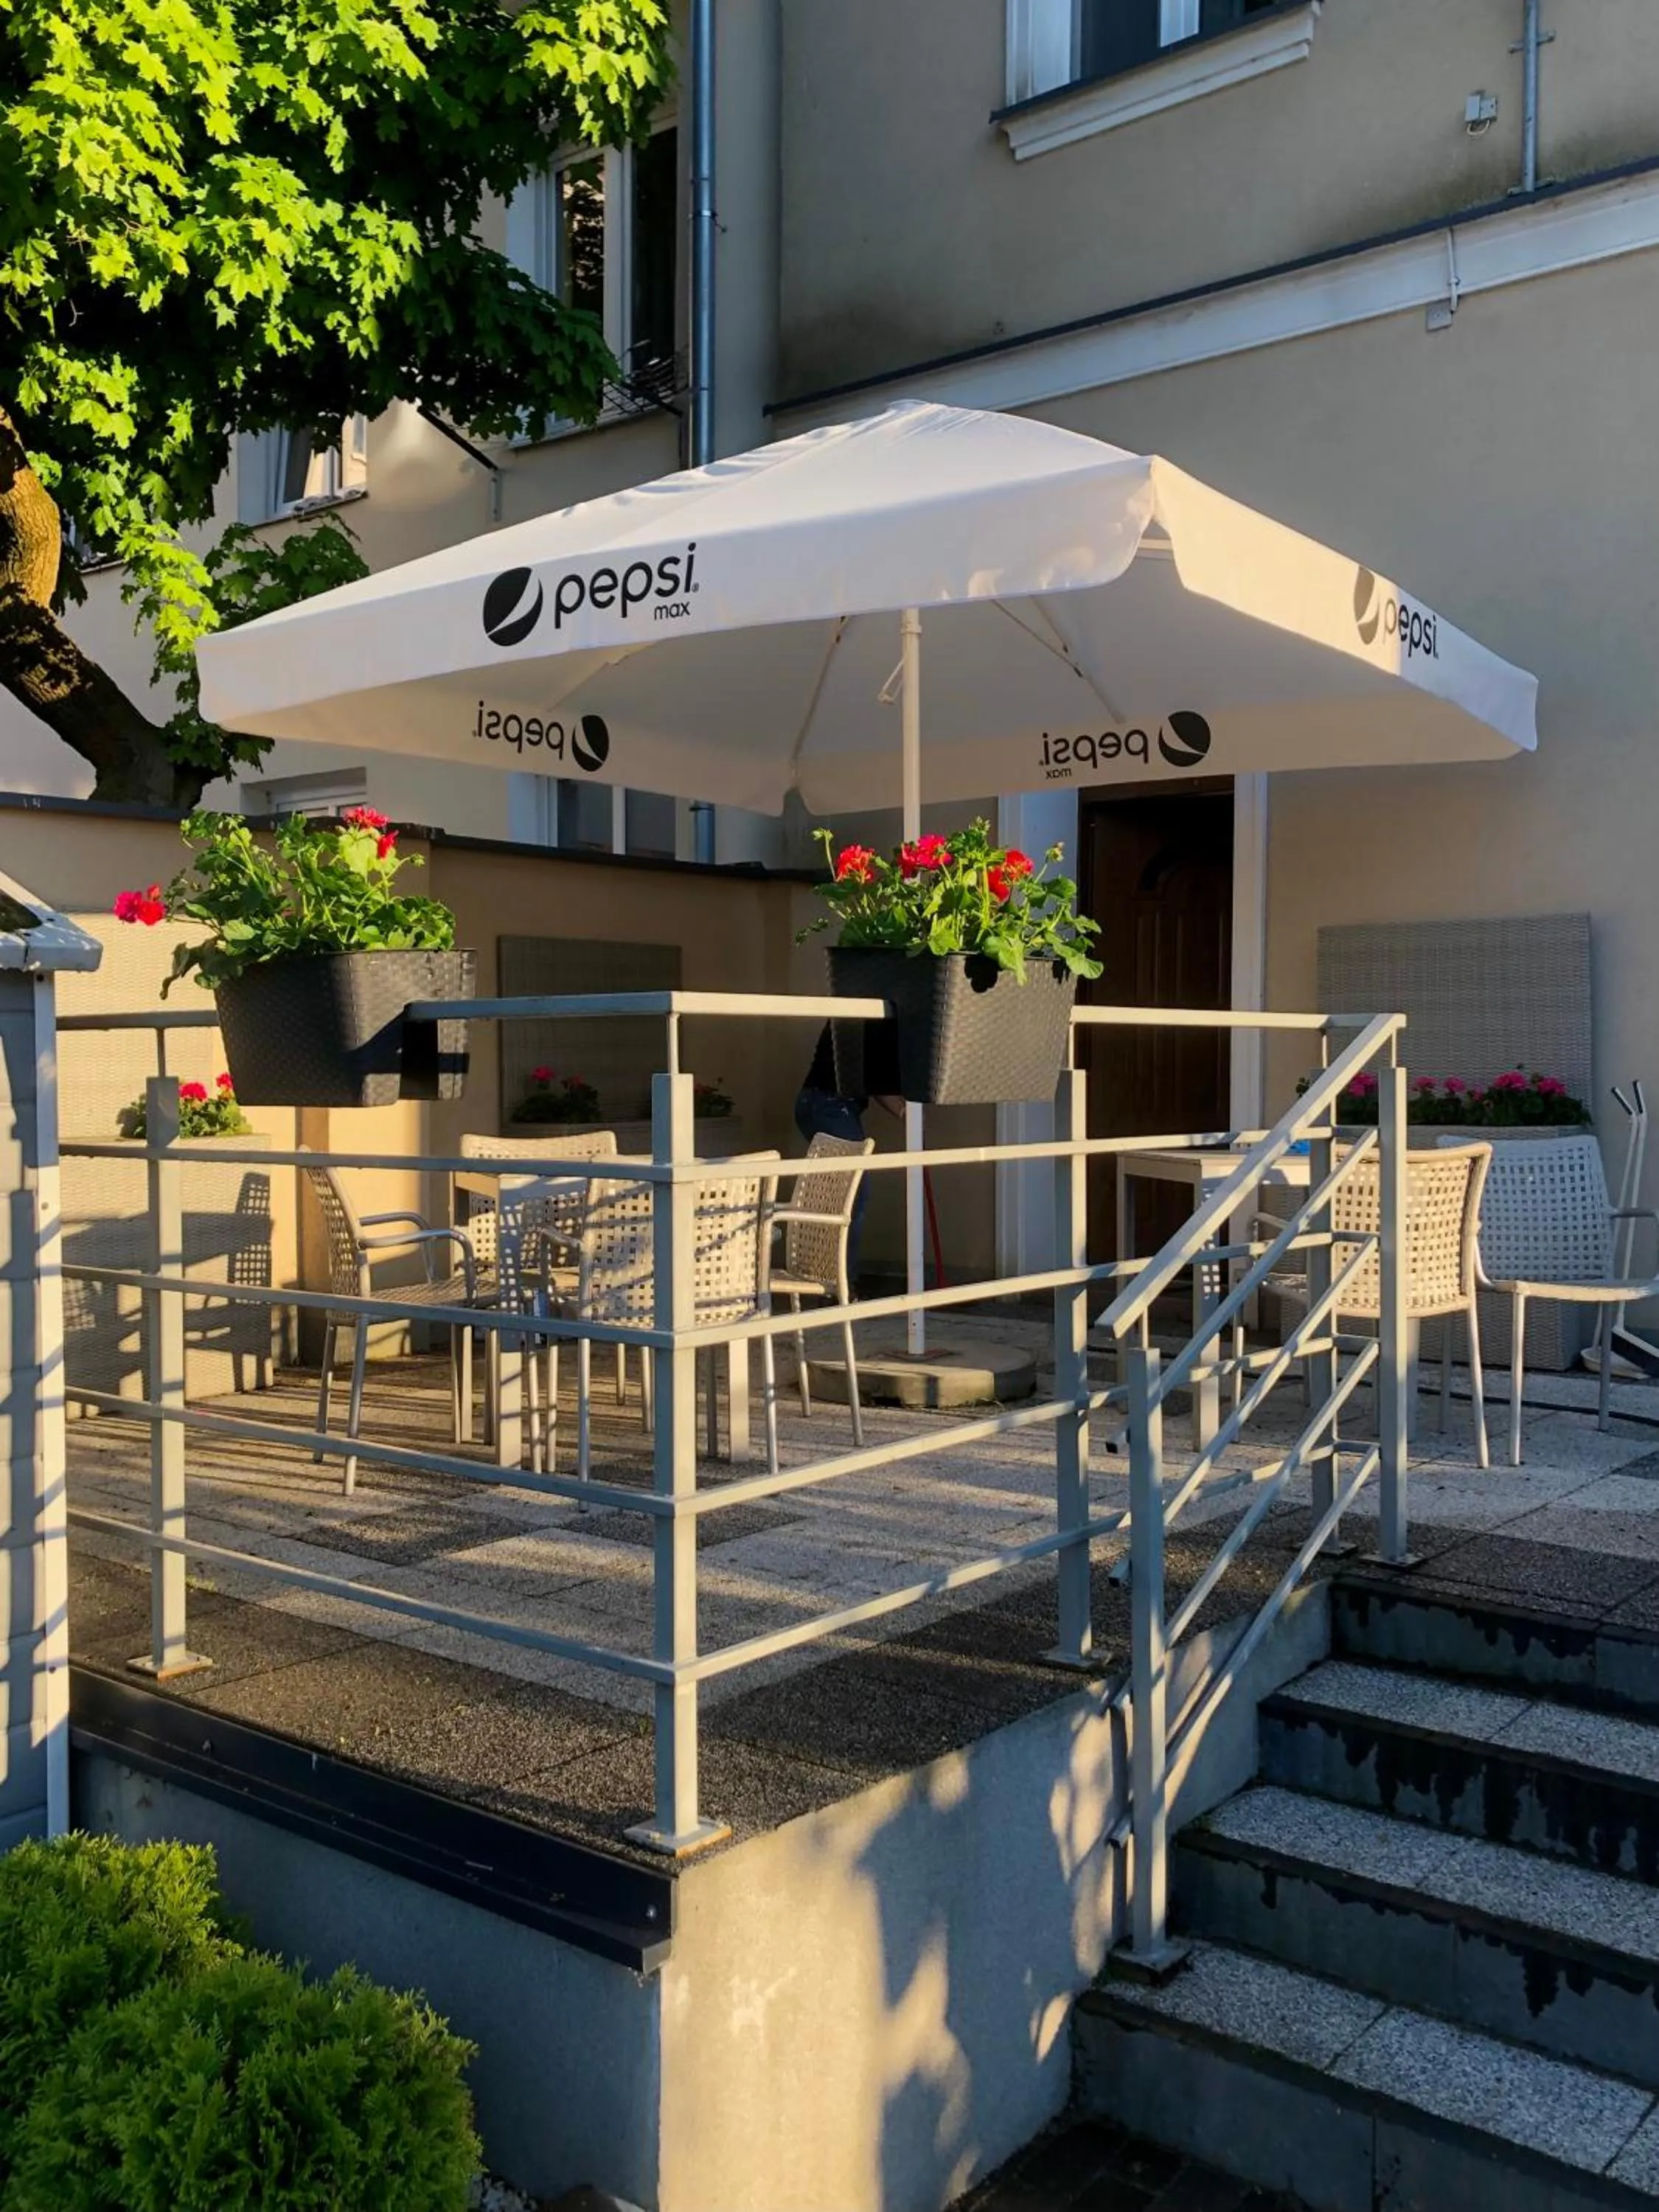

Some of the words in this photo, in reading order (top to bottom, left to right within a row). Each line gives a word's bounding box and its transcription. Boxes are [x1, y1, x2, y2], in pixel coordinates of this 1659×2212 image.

[554, 542, 696, 629] pepsi
[654, 601, 691, 621] max
[1382, 597, 1437, 658] pepsi
